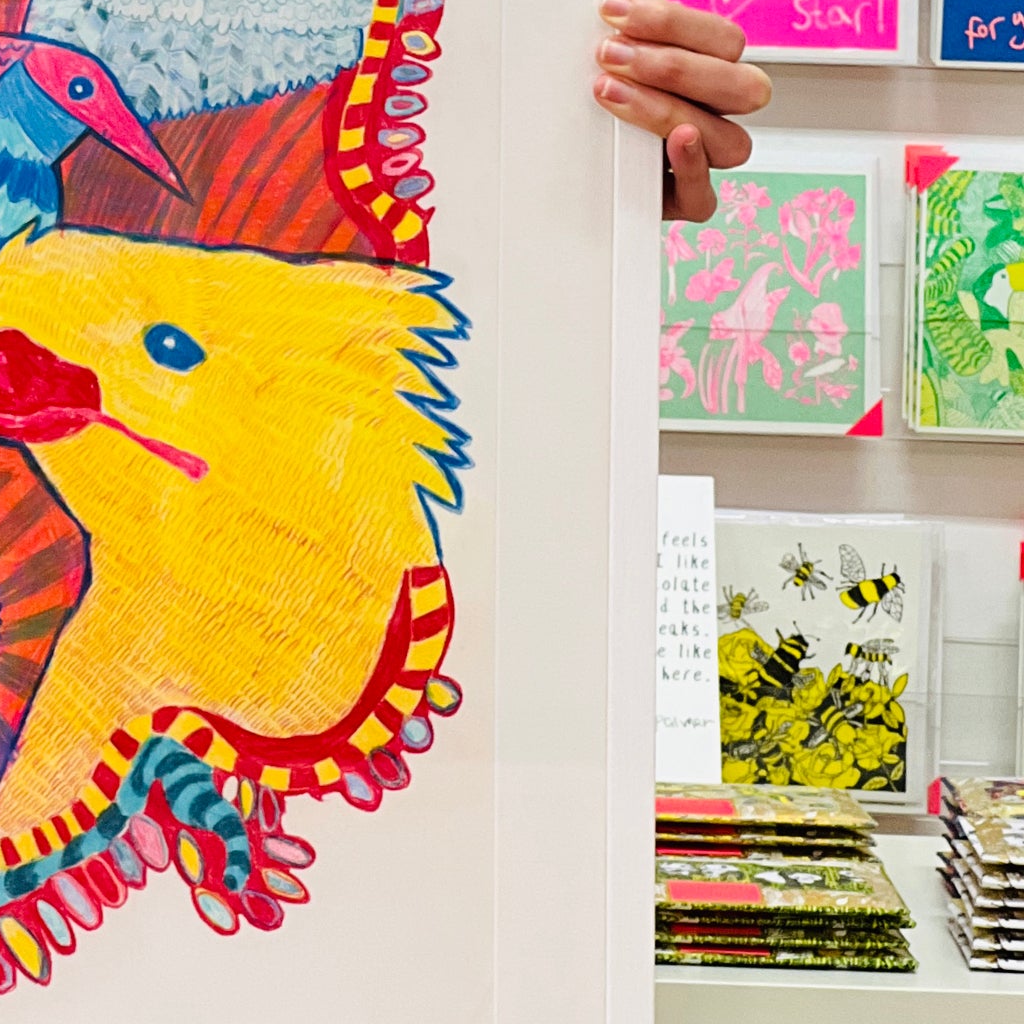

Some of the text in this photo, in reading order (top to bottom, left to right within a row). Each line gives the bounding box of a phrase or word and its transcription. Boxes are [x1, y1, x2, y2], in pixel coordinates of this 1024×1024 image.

[965, 15, 1006, 50] for
[662, 530, 708, 548] feels
[677, 553, 710, 569] like
[683, 598, 710, 614] the
[679, 643, 712, 659] like
[662, 666, 711, 682] here.
